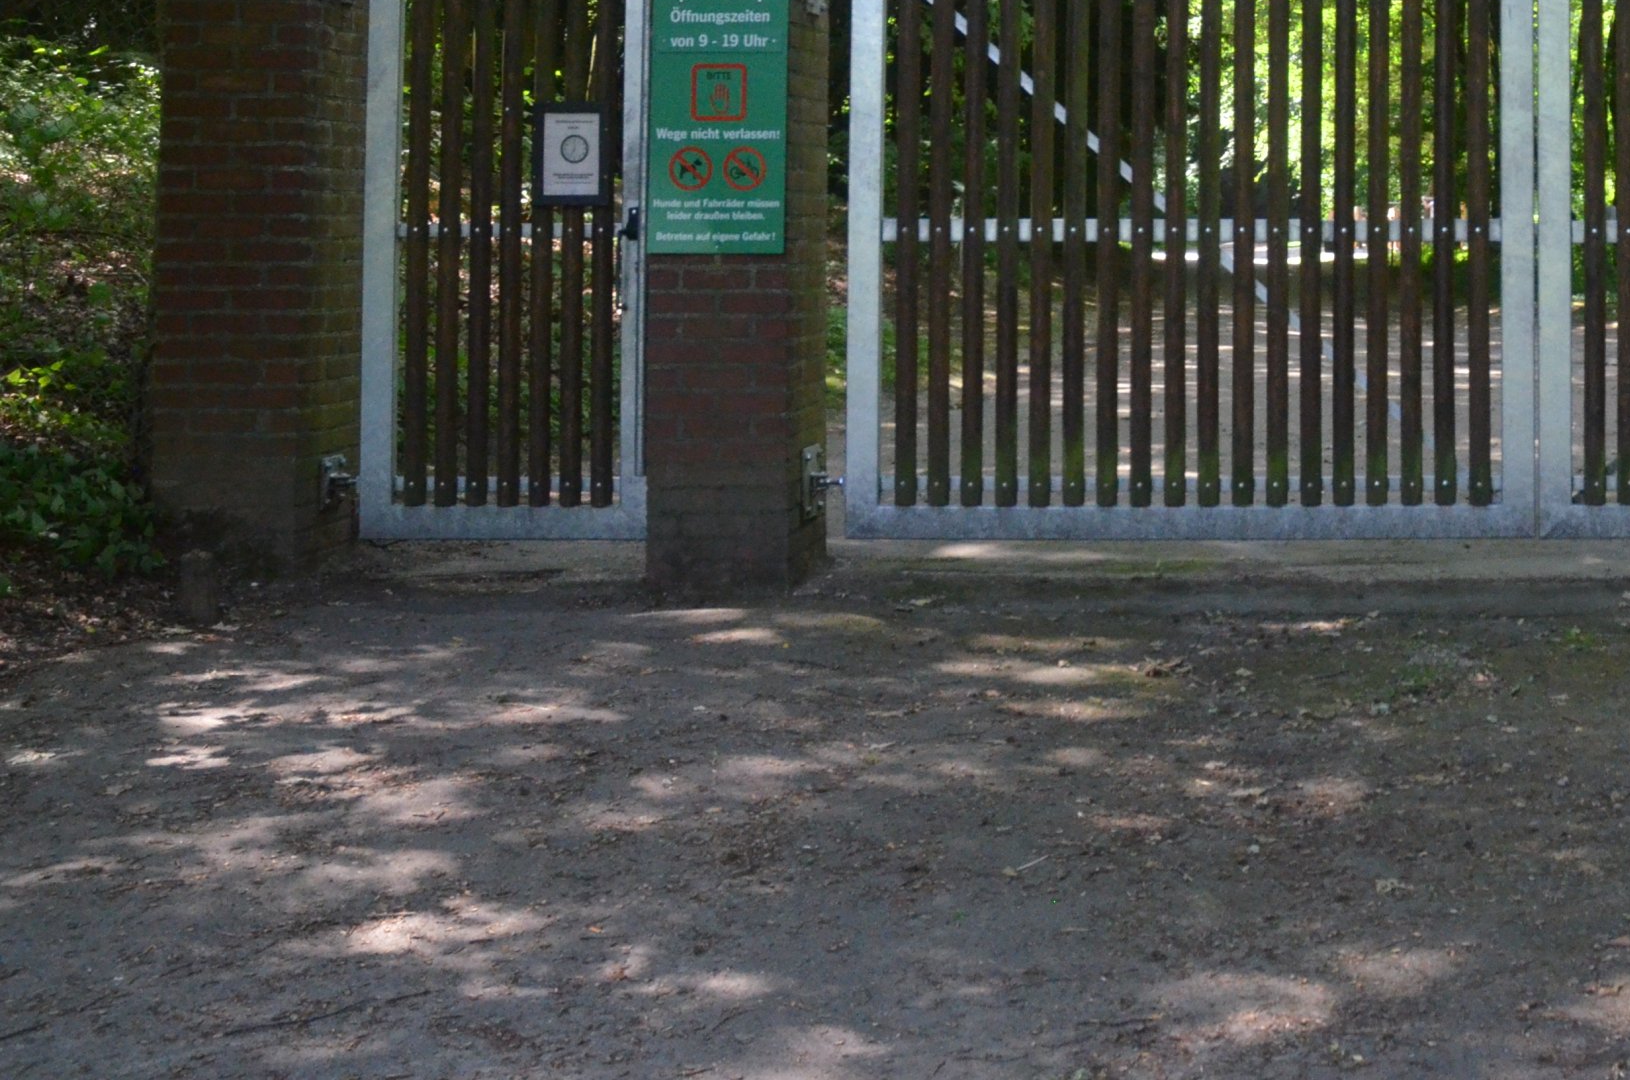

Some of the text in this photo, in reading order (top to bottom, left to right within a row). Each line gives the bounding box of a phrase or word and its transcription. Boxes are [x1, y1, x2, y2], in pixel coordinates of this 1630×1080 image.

[670, 6, 770, 25] Öffnungszeiten
[670, 37, 694, 47] von
[698, 34, 708, 47] 9
[722, 34, 738, 47] 19
[743, 34, 768, 47] Uhr
[656, 128, 780, 141] Wege nicht verlassen!
[653, 199, 779, 208] Hunde und Fahrräder müssen
[667, 212, 691, 220] leider
[694, 212, 729, 220] draußen
[656, 232, 693, 241] Betreten
[695, 232, 709, 241] auf
[712, 232, 740, 242] eigene
